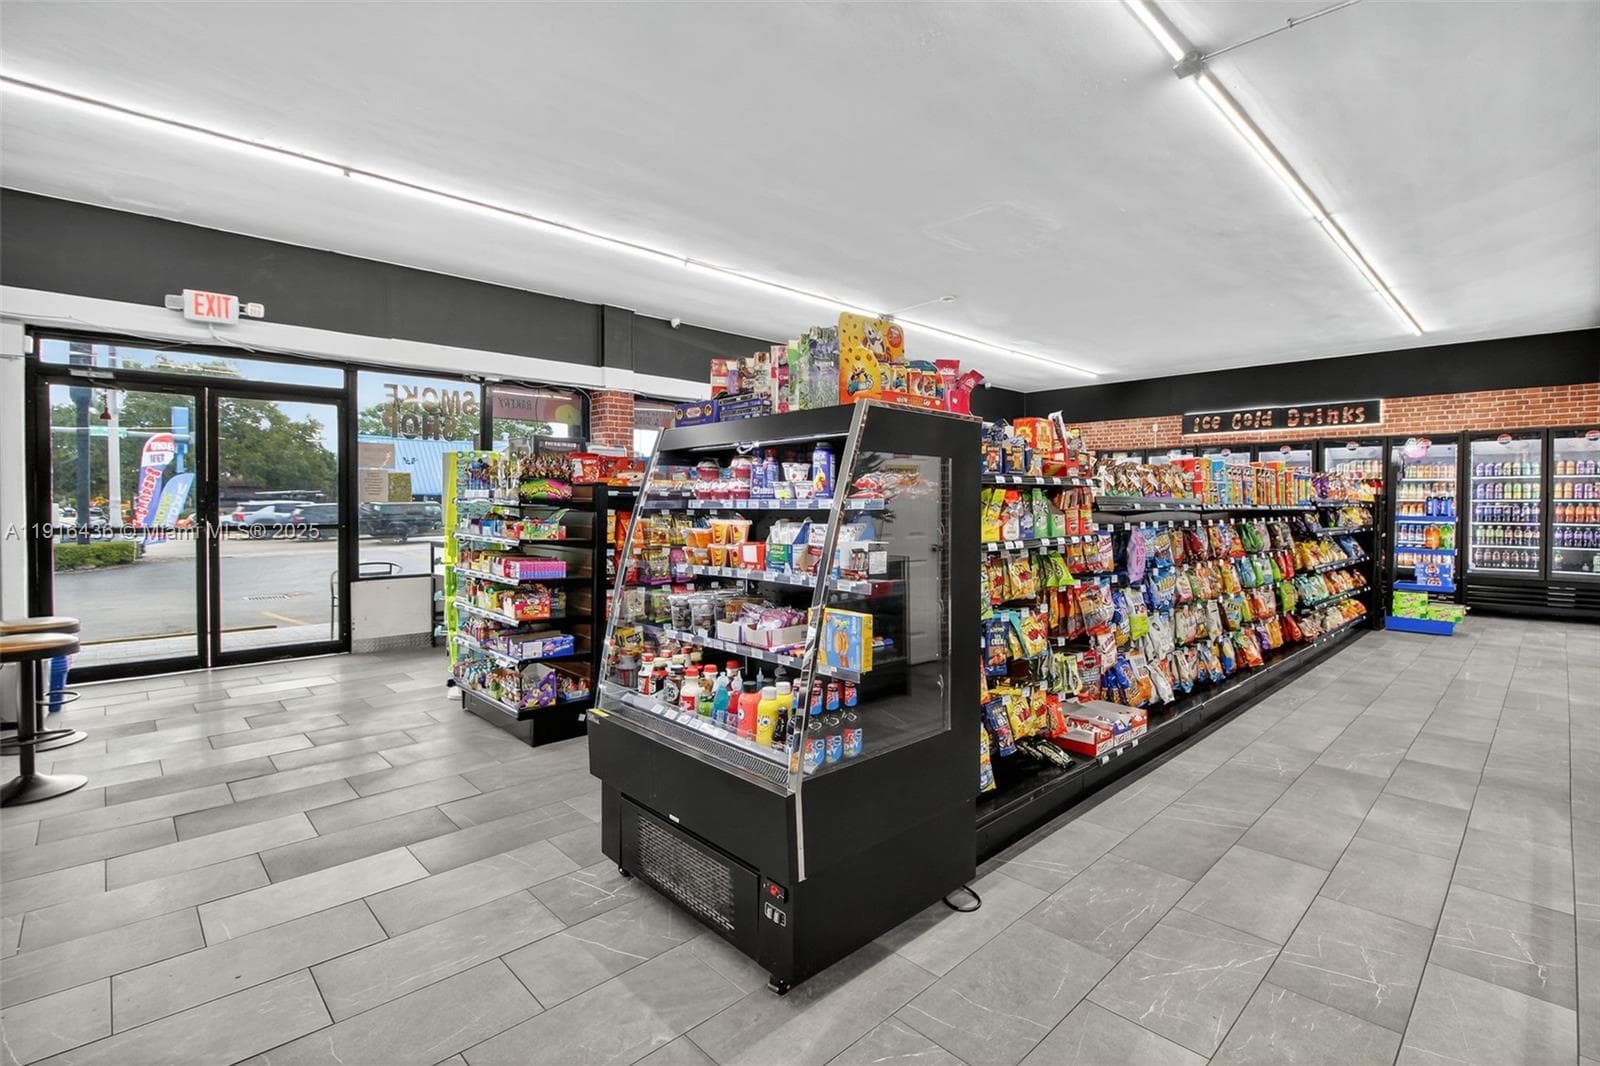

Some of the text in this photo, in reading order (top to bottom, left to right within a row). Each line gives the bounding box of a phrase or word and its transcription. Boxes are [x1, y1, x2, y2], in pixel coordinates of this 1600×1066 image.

[193, 292, 232, 320] EXIT
[1231, 410, 1273, 430] Cold
[1287, 406, 1366, 427] Drinks
